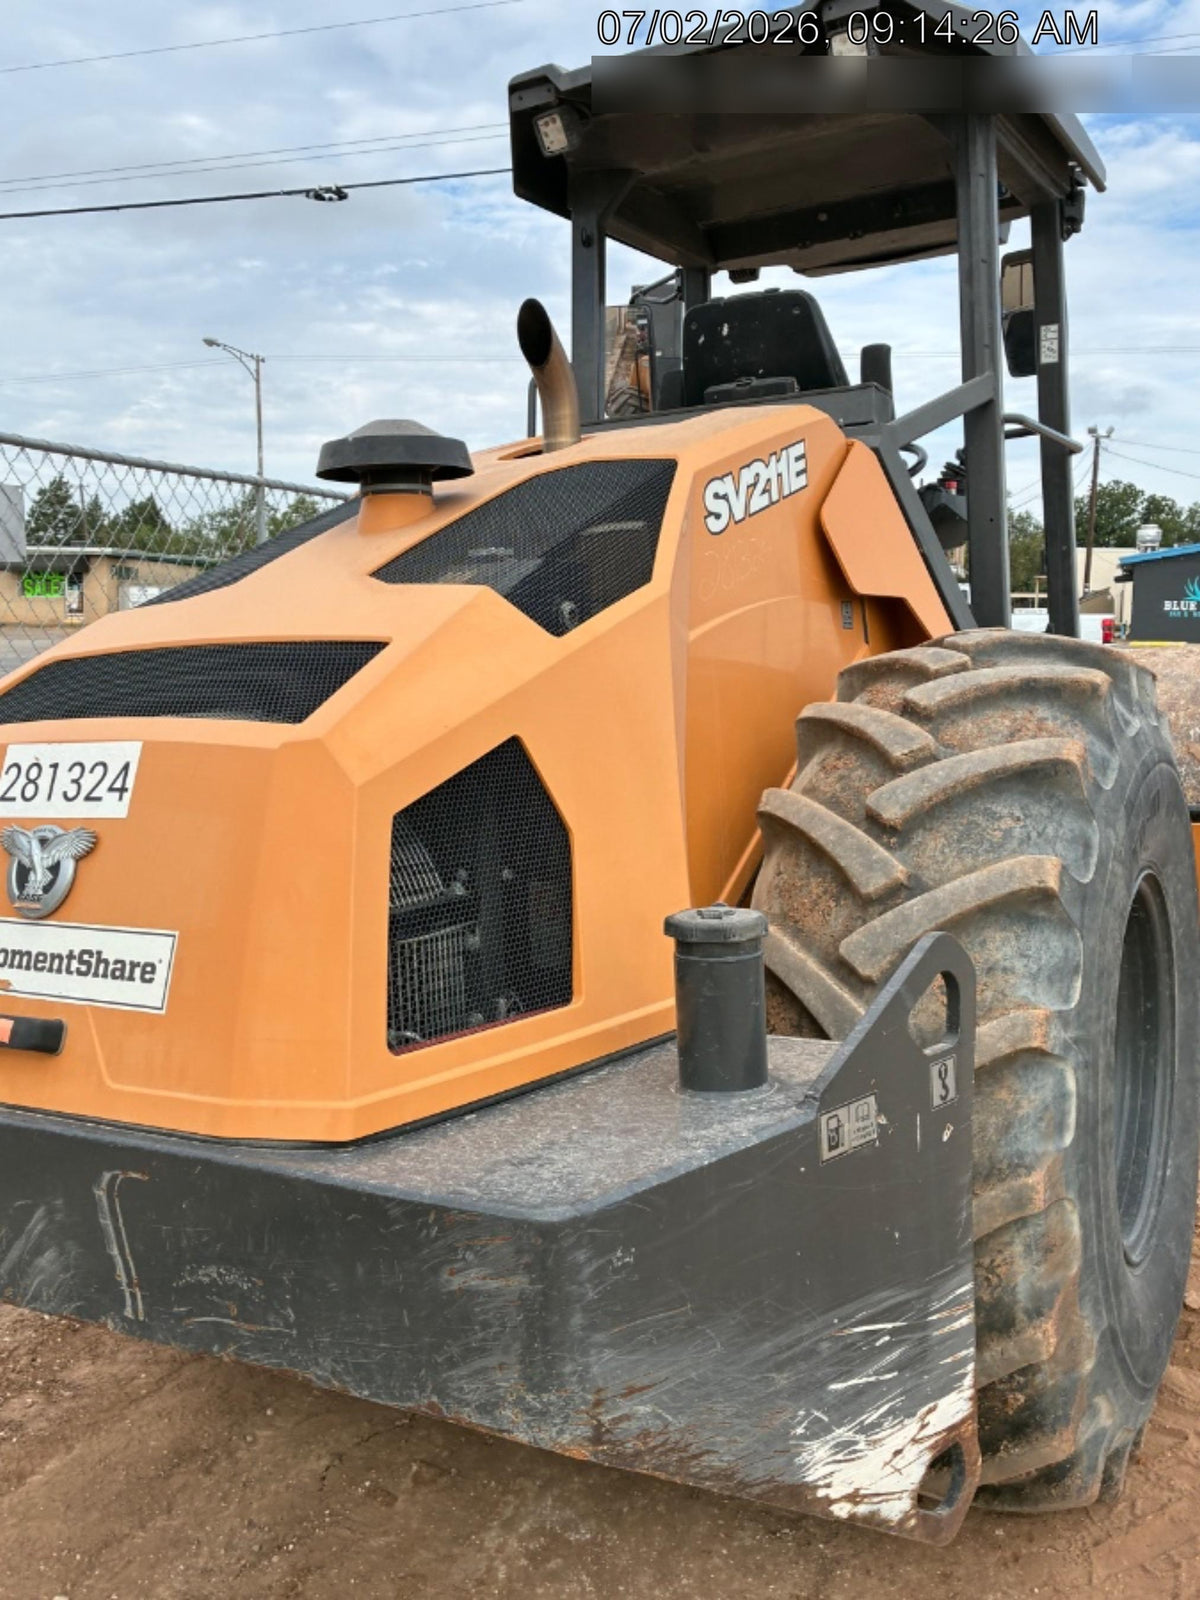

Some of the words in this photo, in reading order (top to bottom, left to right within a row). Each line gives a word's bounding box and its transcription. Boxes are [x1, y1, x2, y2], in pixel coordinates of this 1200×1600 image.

[703, 438, 808, 535] SV211E
[23, 578, 61, 598] SALE
[1163, 600, 1198, 611] BLUE
[0, 760, 132, 803] 281324
